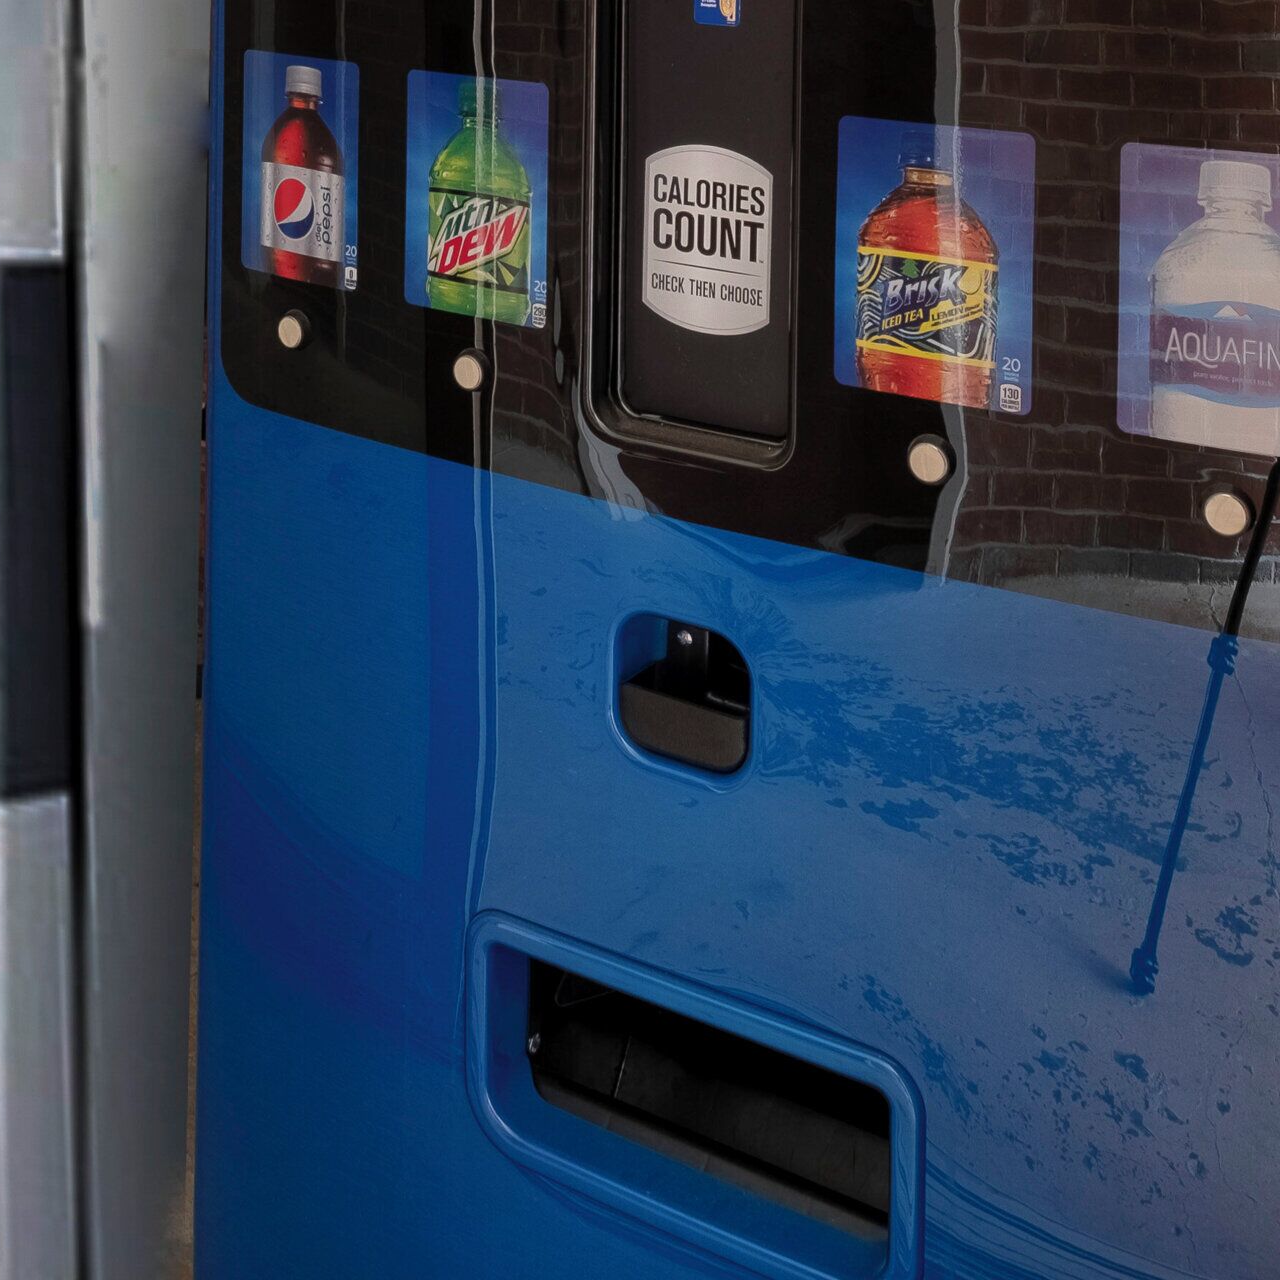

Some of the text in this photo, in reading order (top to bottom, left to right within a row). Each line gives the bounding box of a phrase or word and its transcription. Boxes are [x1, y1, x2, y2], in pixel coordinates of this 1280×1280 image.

[653, 173, 765, 217] CALORIES
[321, 186, 333, 245] pepsi
[345, 245, 358, 258] 20
[534, 280, 547, 294] 20
[651, 272, 763, 307] CHECK THEN CHOOSE
[881, 313, 902, 331] ICED
[904, 308, 924, 324] TEA
[1002, 356, 1021, 372] 20
[1002, 387, 1019, 400] 130
